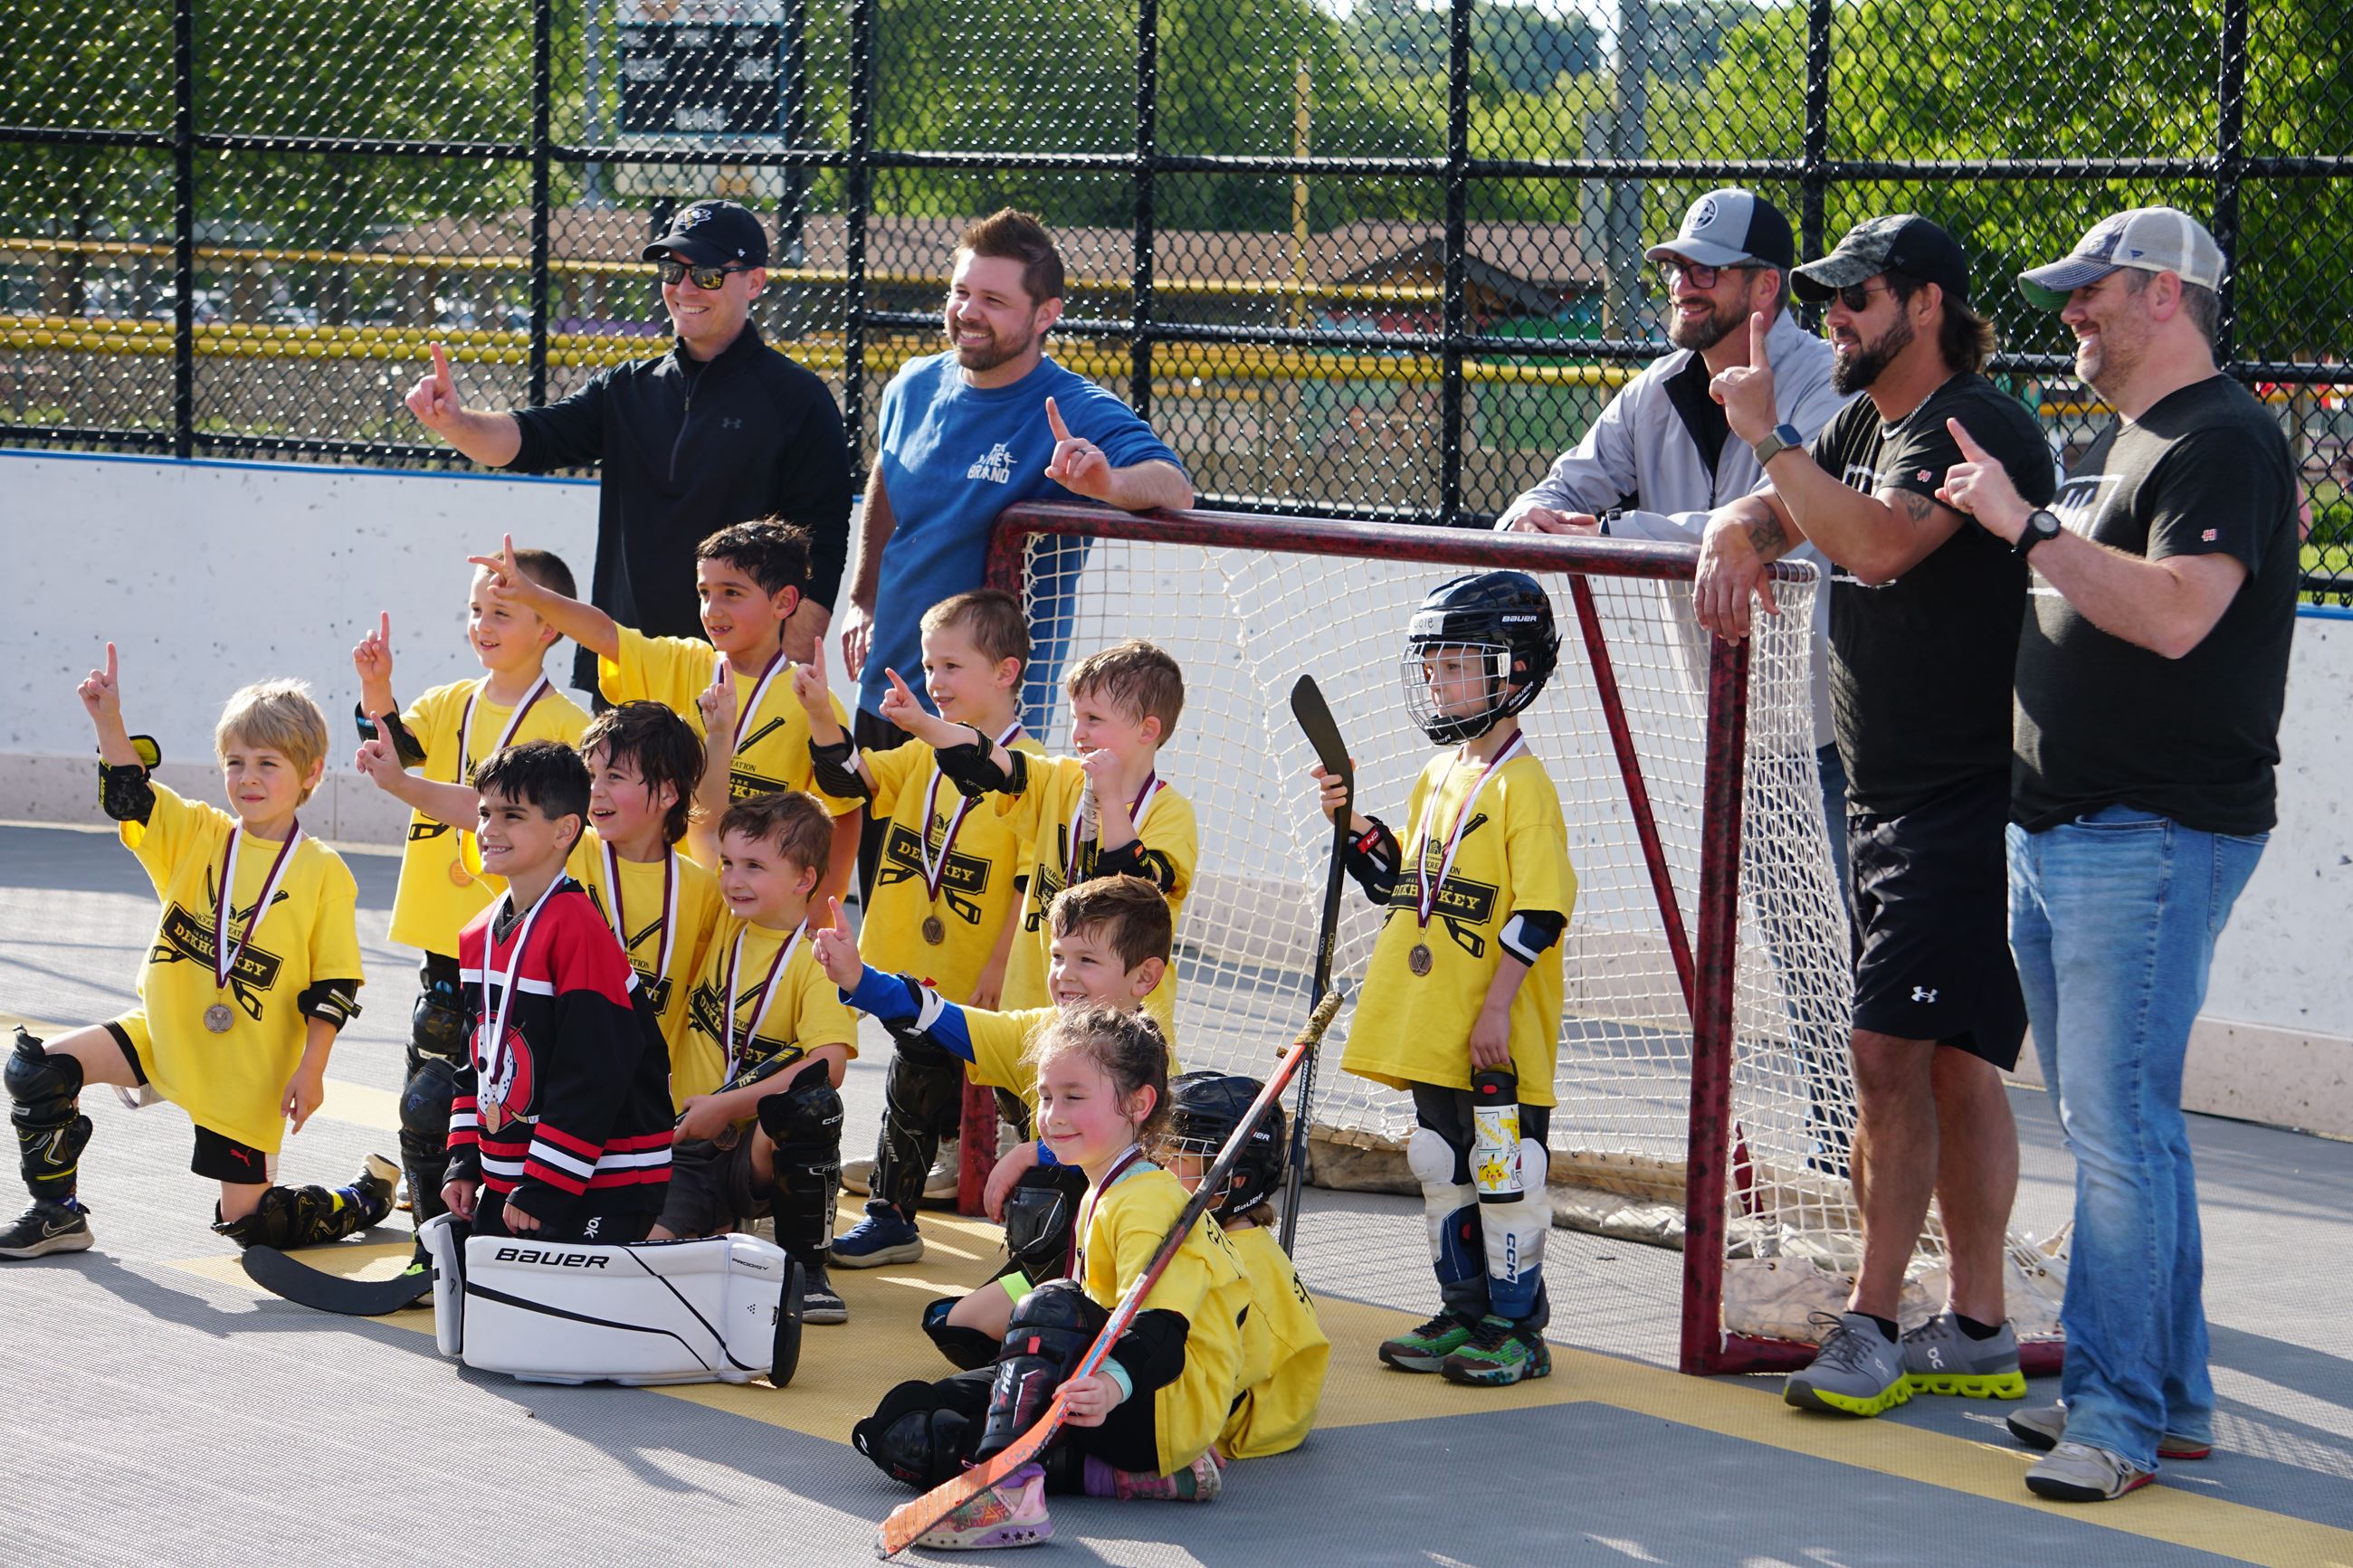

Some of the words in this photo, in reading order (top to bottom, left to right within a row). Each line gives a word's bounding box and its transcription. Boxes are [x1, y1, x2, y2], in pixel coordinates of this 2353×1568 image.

[967, 464, 1010, 484] BRAND
[1501, 614, 1538, 623] BAUER
[1508, 680, 1535, 708] BAUER
[1325, 932, 1335, 966] 5000
[1300, 1041, 1320, 1148] SHERWOO
[1233, 1192, 1264, 1213] BAUER
[494, 1247, 610, 1269] BAUER
[731, 1257, 770, 1270] PRODIGY
[1505, 1231, 1518, 1281] CCM
